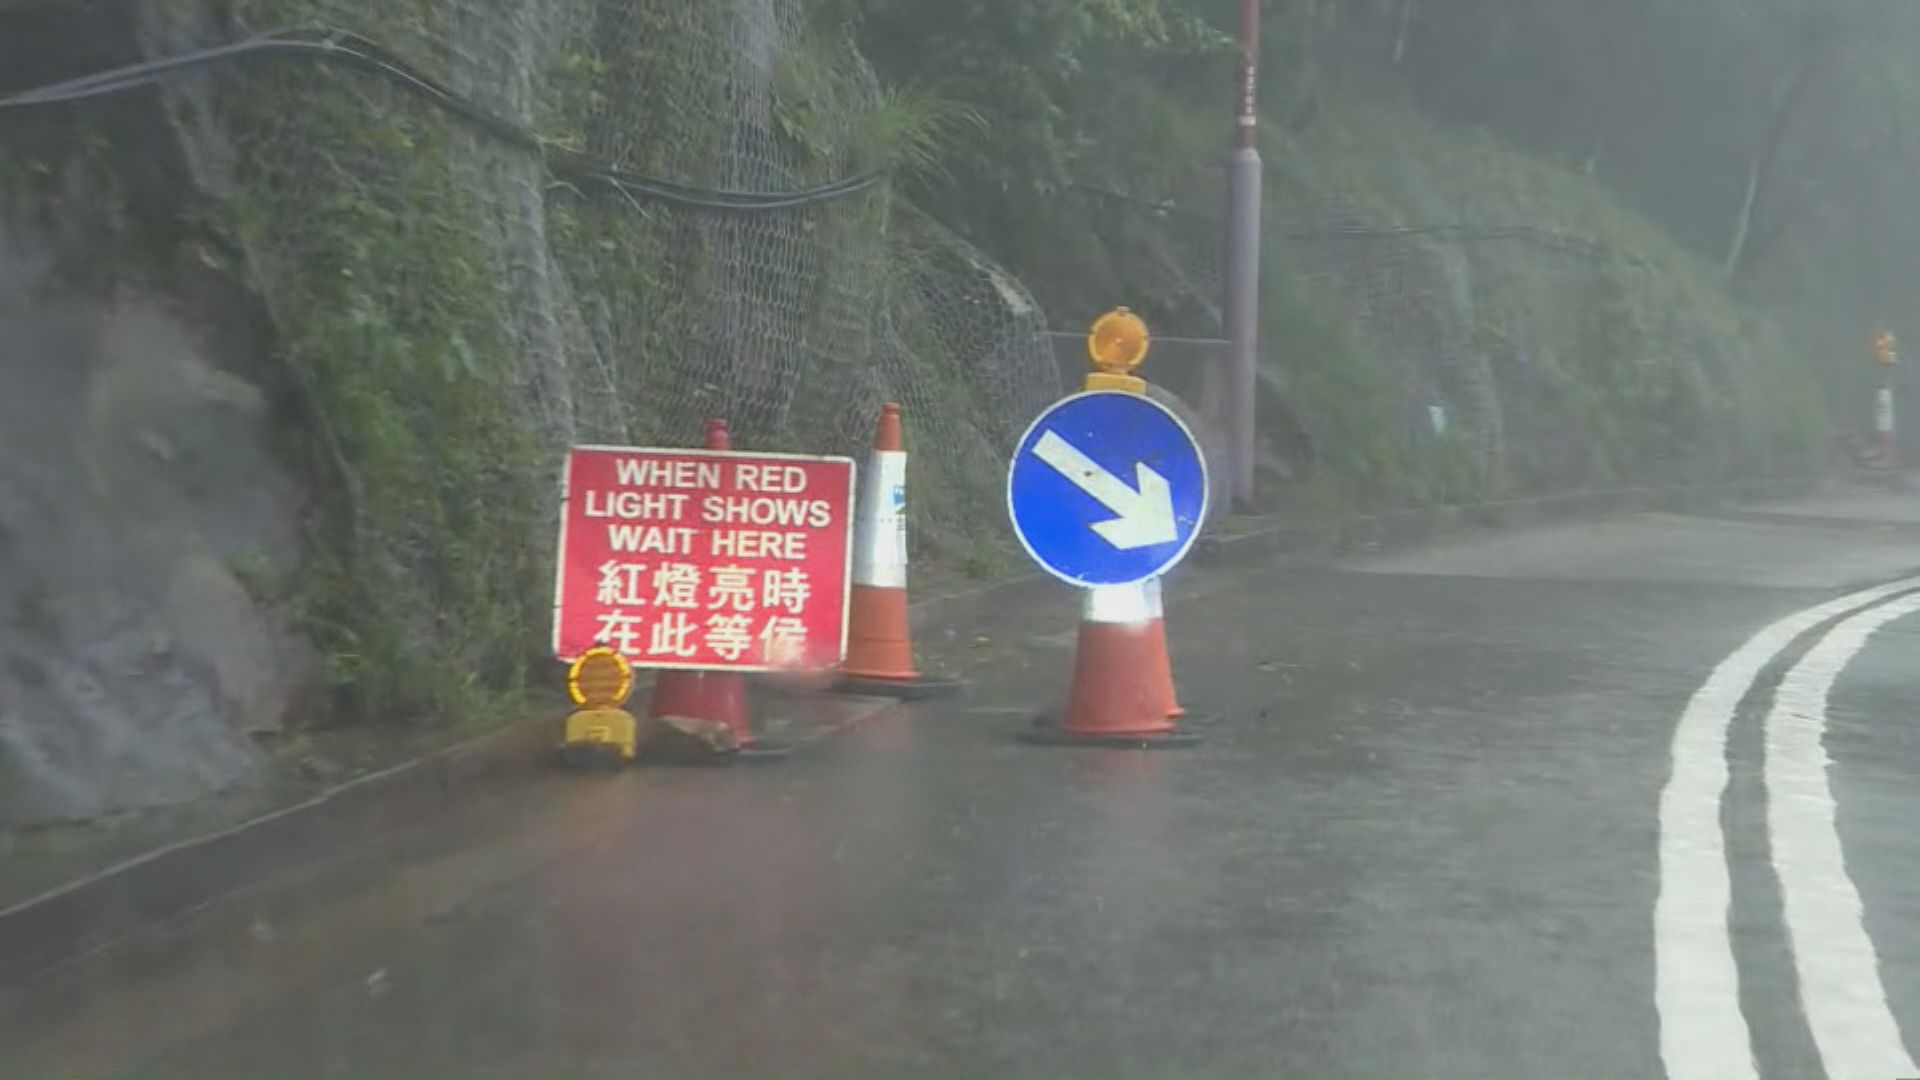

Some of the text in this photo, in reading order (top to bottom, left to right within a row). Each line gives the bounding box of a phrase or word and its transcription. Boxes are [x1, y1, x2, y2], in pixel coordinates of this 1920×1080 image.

[616, 458, 807, 494] WHEN RED
[584, 490, 832, 527] LIGHT SHOWS
[607, 524, 807, 560] WAIT HERE
[596, 560, 812, 613] 紅燈亮時
